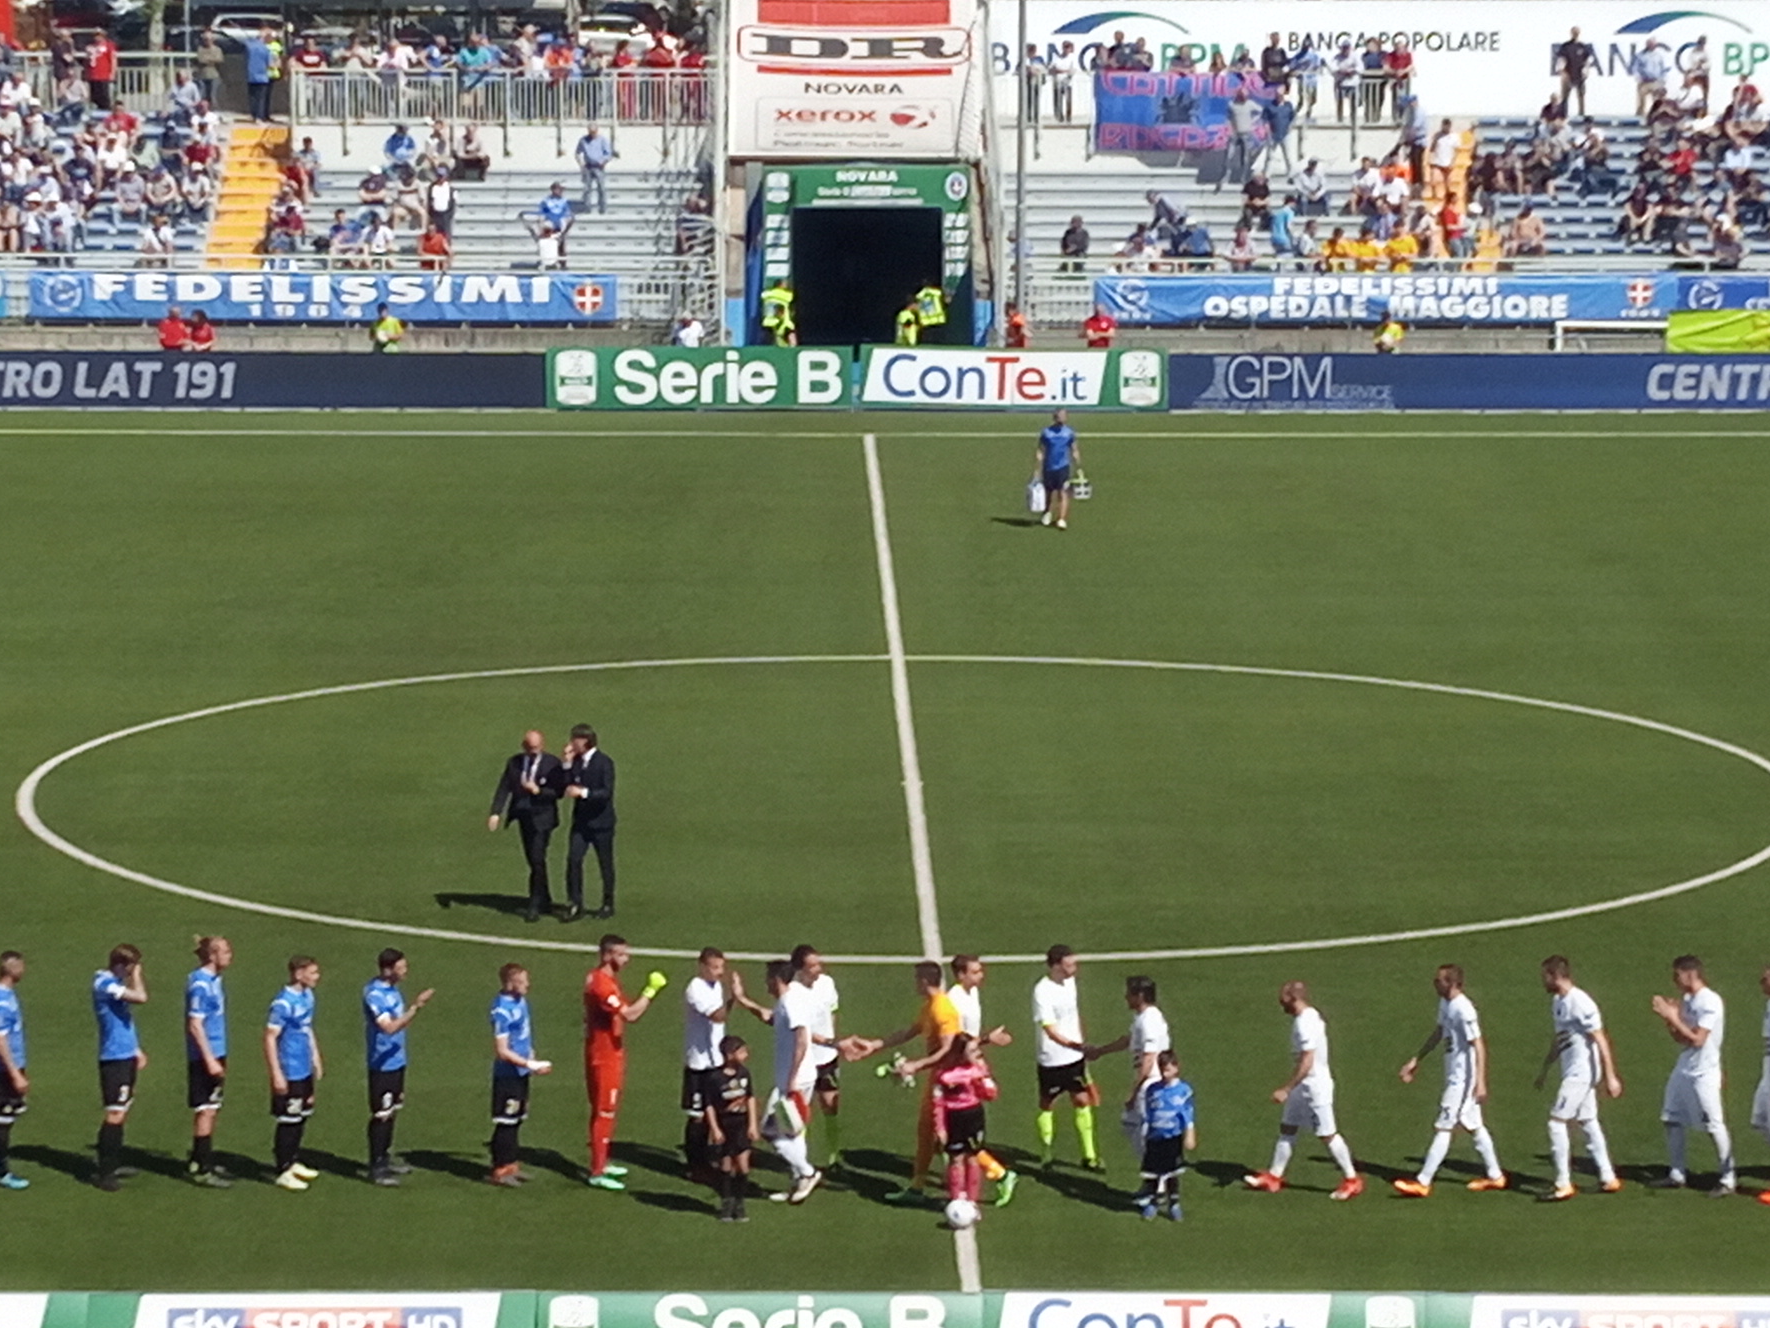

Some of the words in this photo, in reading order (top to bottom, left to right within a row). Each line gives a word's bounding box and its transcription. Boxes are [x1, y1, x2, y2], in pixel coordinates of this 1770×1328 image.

[749, 32, 962, 60] DR
[803, 82, 905, 95] NOVARA
[774, 108, 877, 123] xerox
[93, 275, 551, 304] FEDELISSIMI
[1272, 276, 1498, 297] FEDELISSIMI
[1202, 295, 1369, 319] OSPEDALE
[1387, 293, 1569, 318] MAGGIORE
[73, 361, 162, 399] LAT
[172, 361, 237, 399] 191
[613, 349, 792, 406] Serie
[798, 351, 844, 404] B
[881, 352, 1088, 403] ConTe.it
[1228, 355, 1333, 400] GPM
